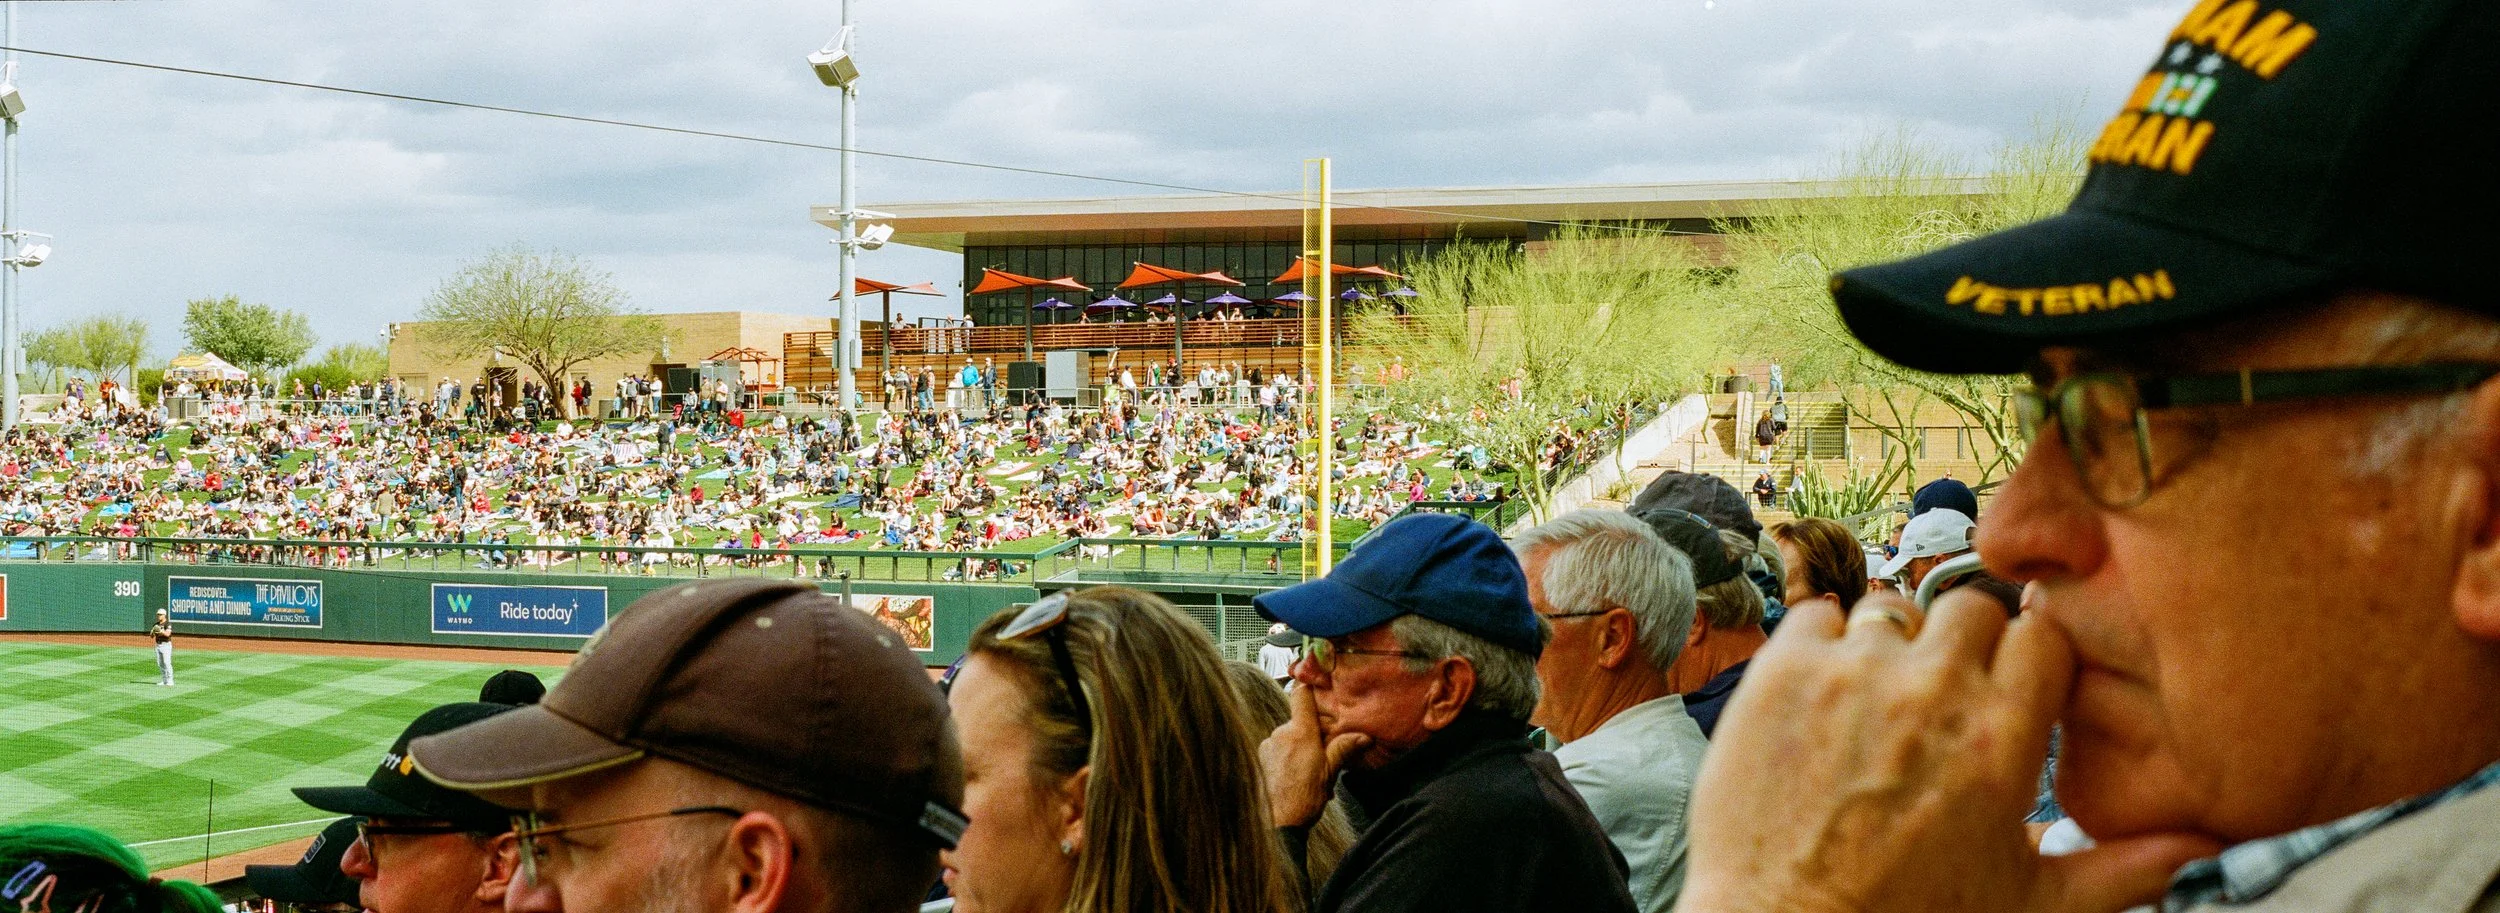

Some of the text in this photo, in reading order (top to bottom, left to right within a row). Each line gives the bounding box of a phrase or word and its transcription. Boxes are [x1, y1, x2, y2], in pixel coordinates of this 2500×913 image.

[1945, 268, 2176, 316] VETERAN
[114, 581, 140, 597] 390
[255, 584, 319, 607] THE PAVILIONS
[171, 600, 208, 614] SHOPPING
[209, 601, 225, 615] AND
[226, 601, 252, 616] DINING
[500, 602, 573, 625] Ride today
[447, 617, 473, 625] WAYMO
